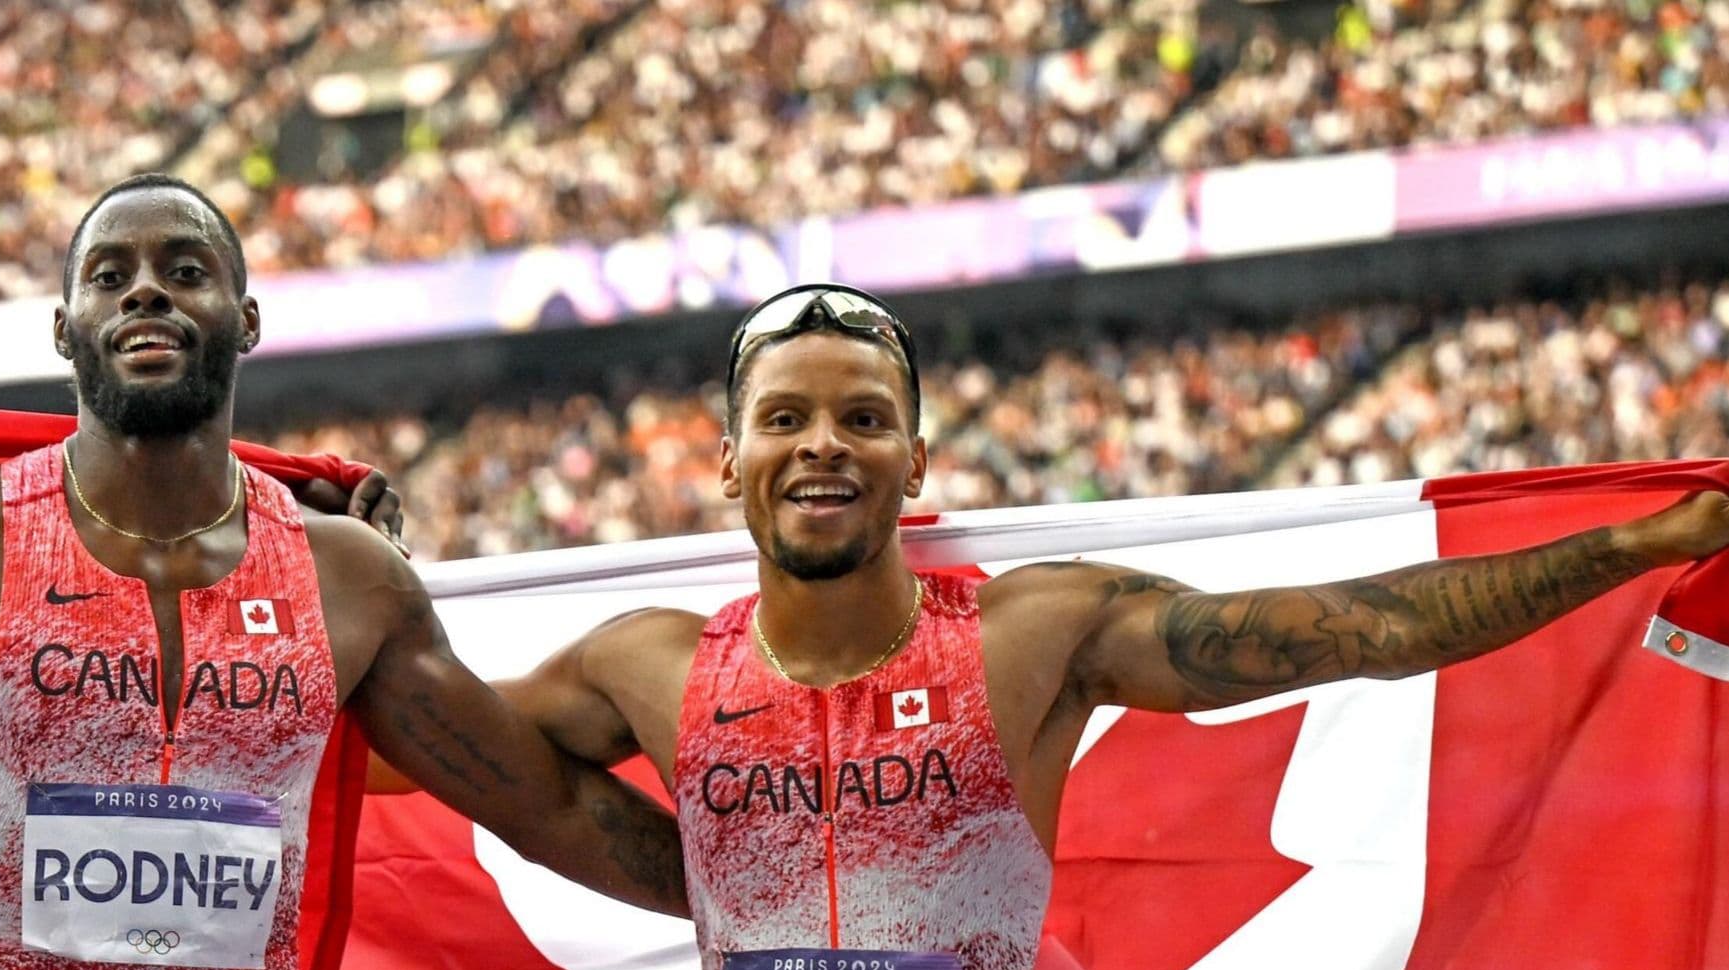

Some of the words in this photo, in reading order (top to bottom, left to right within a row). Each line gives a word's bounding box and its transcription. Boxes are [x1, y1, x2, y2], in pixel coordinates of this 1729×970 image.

[31, 643, 302, 715] CANADA
[168, 794, 223, 812] 2024
[701, 748, 958, 815] CANADA
[33, 848, 276, 911] RODNEY
